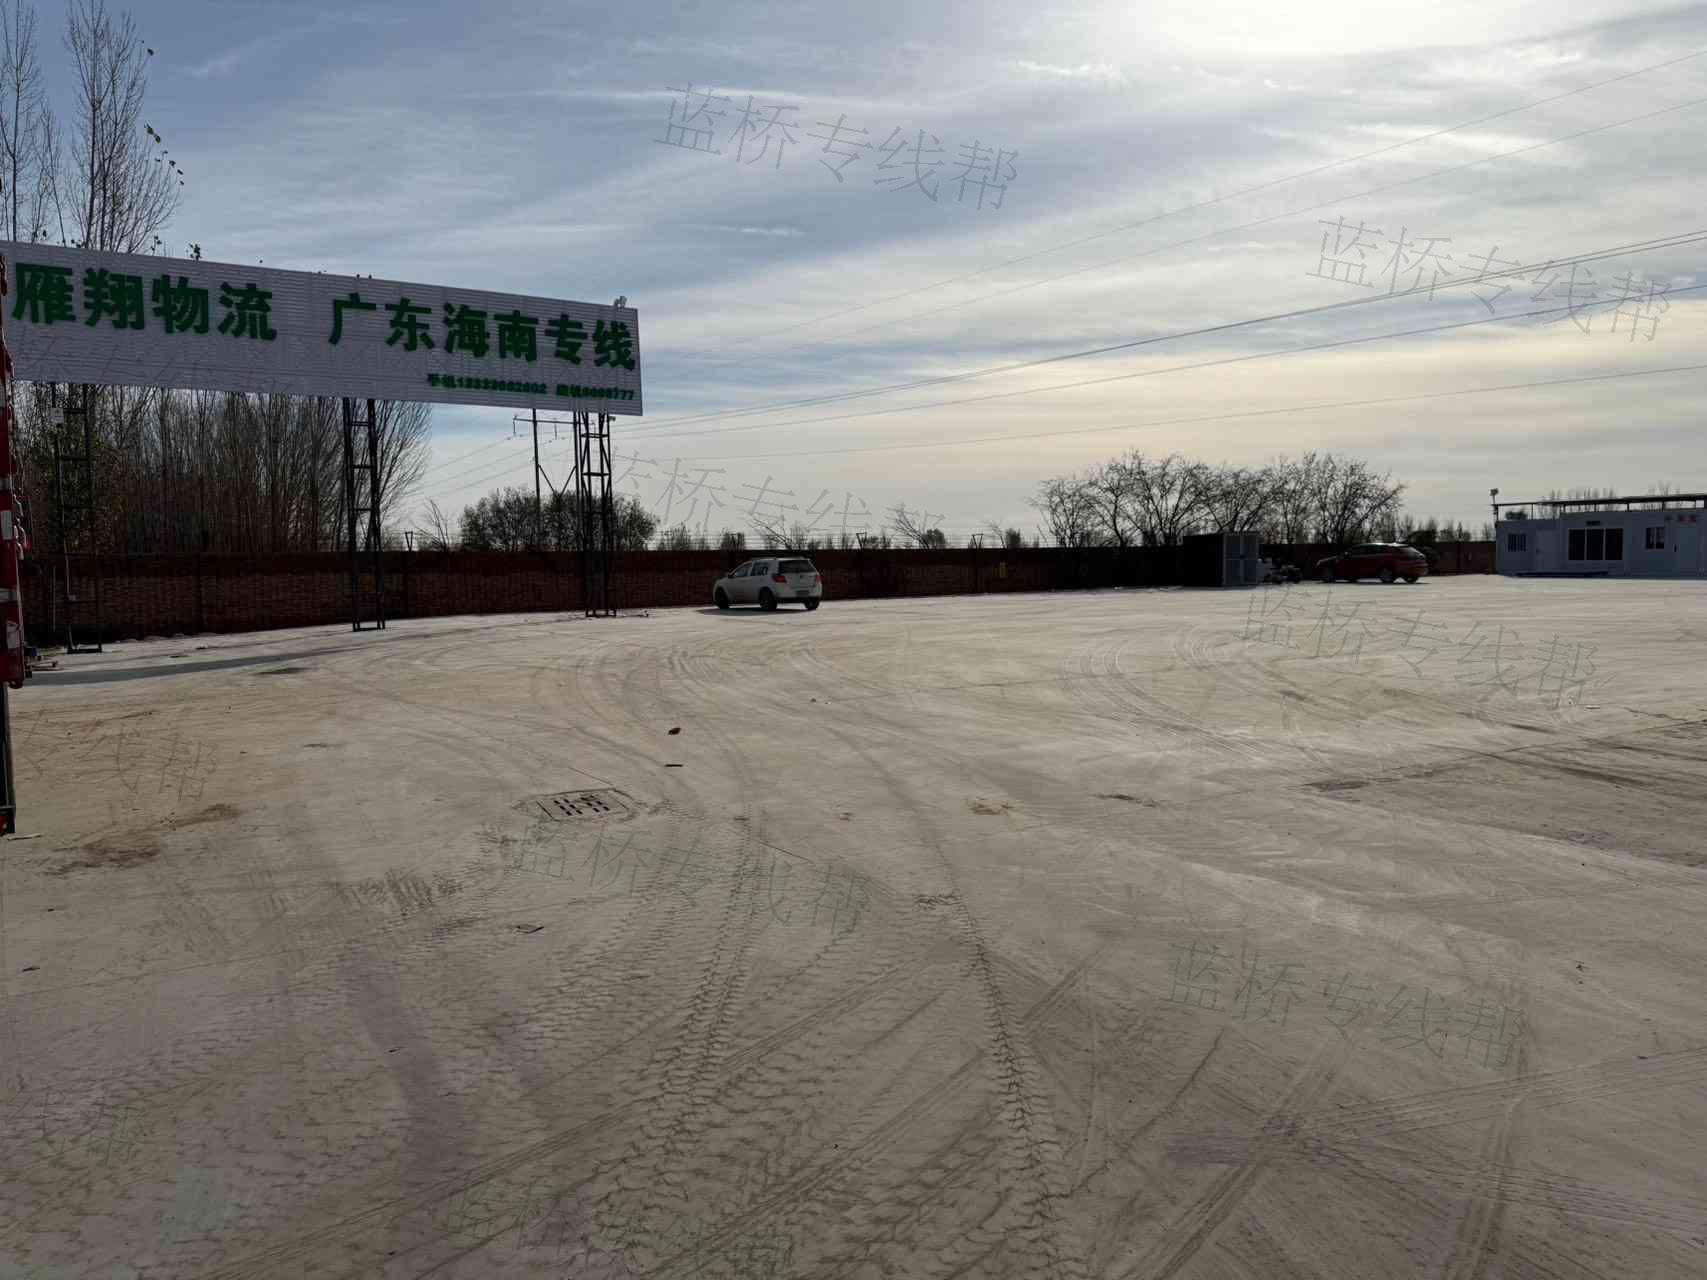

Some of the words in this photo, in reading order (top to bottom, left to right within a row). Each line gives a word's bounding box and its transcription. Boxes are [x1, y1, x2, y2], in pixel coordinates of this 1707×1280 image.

[12, 262, 278, 341] 雁翔物流
[329, 292, 637, 371] 广东海南专线
